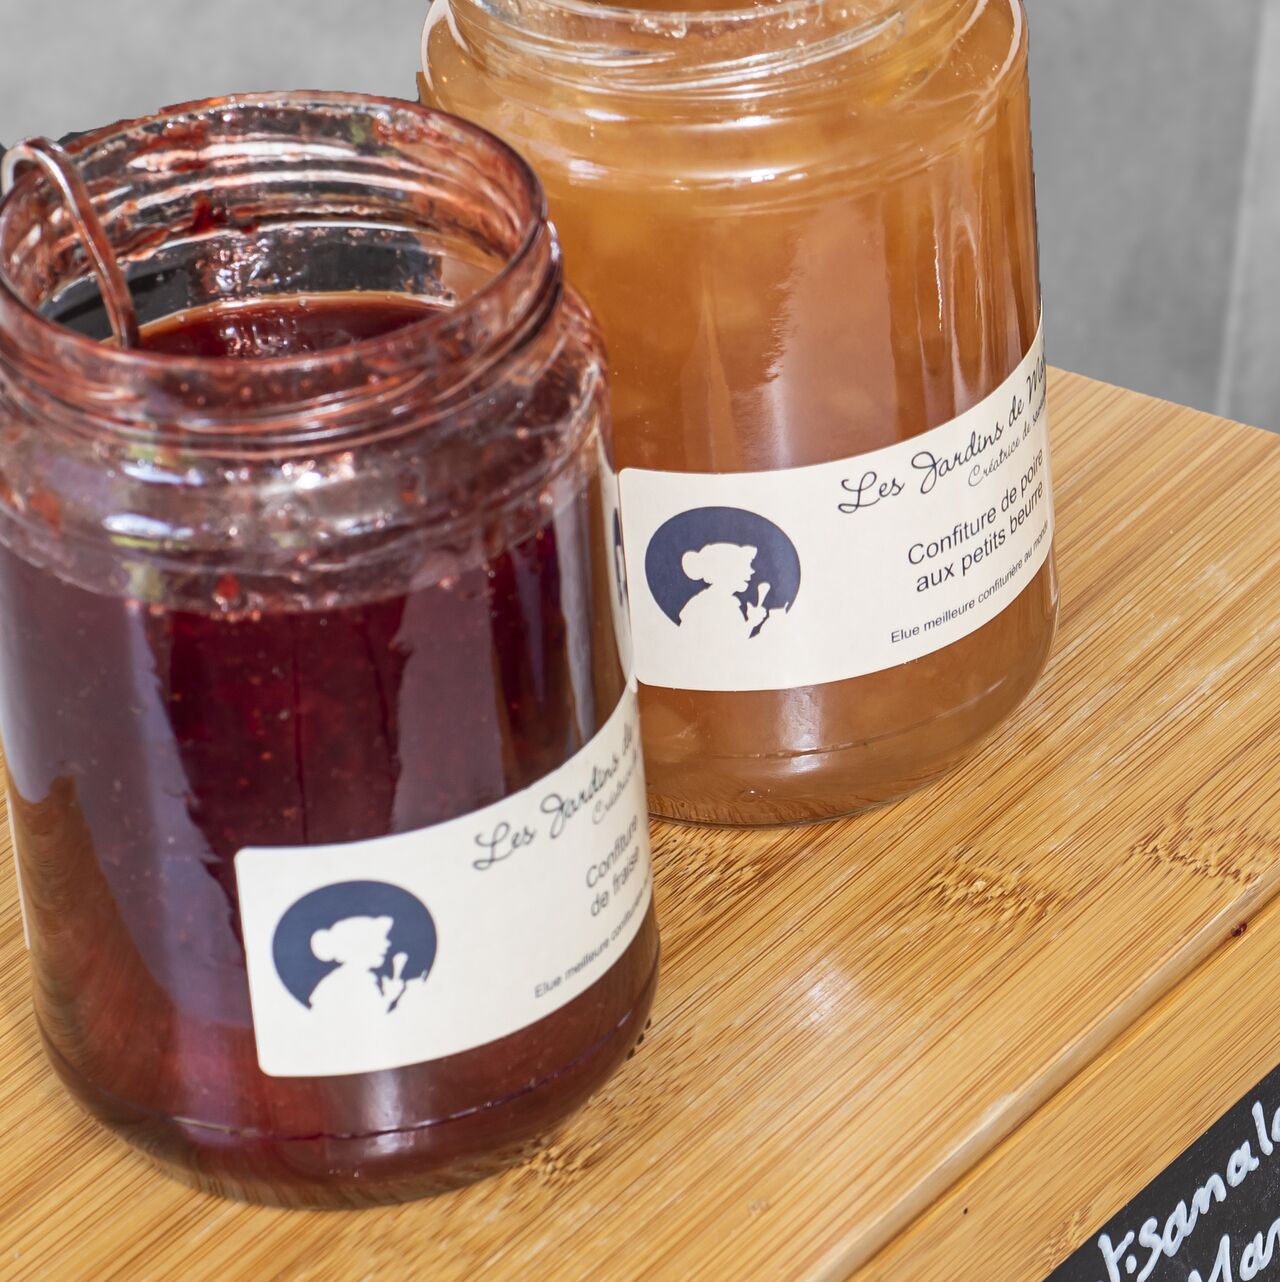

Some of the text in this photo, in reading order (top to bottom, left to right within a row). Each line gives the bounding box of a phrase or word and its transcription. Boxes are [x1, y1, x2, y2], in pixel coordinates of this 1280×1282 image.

[838, 471, 905, 514] Les
[910, 420, 1005, 495] Jardins
[1008, 394, 1024, 428] de
[967, 437, 1020, 487] Créatrice
[907, 448, 1043, 565] Confiture de poire
[916, 480, 1043, 593] aux petits beurre
[890, 625, 921, 644] Elue
[923, 598, 976, 632] meilleure
[977, 558, 1023, 605] confiturière
[1023, 546, 1033, 563] au
[473, 820, 537, 871] Les
[539, 752, 620, 840] Jardins
[585, 814, 638, 889] Confiture
[590, 889, 610, 918] de
[533, 936, 610, 999] Elue meilleure
